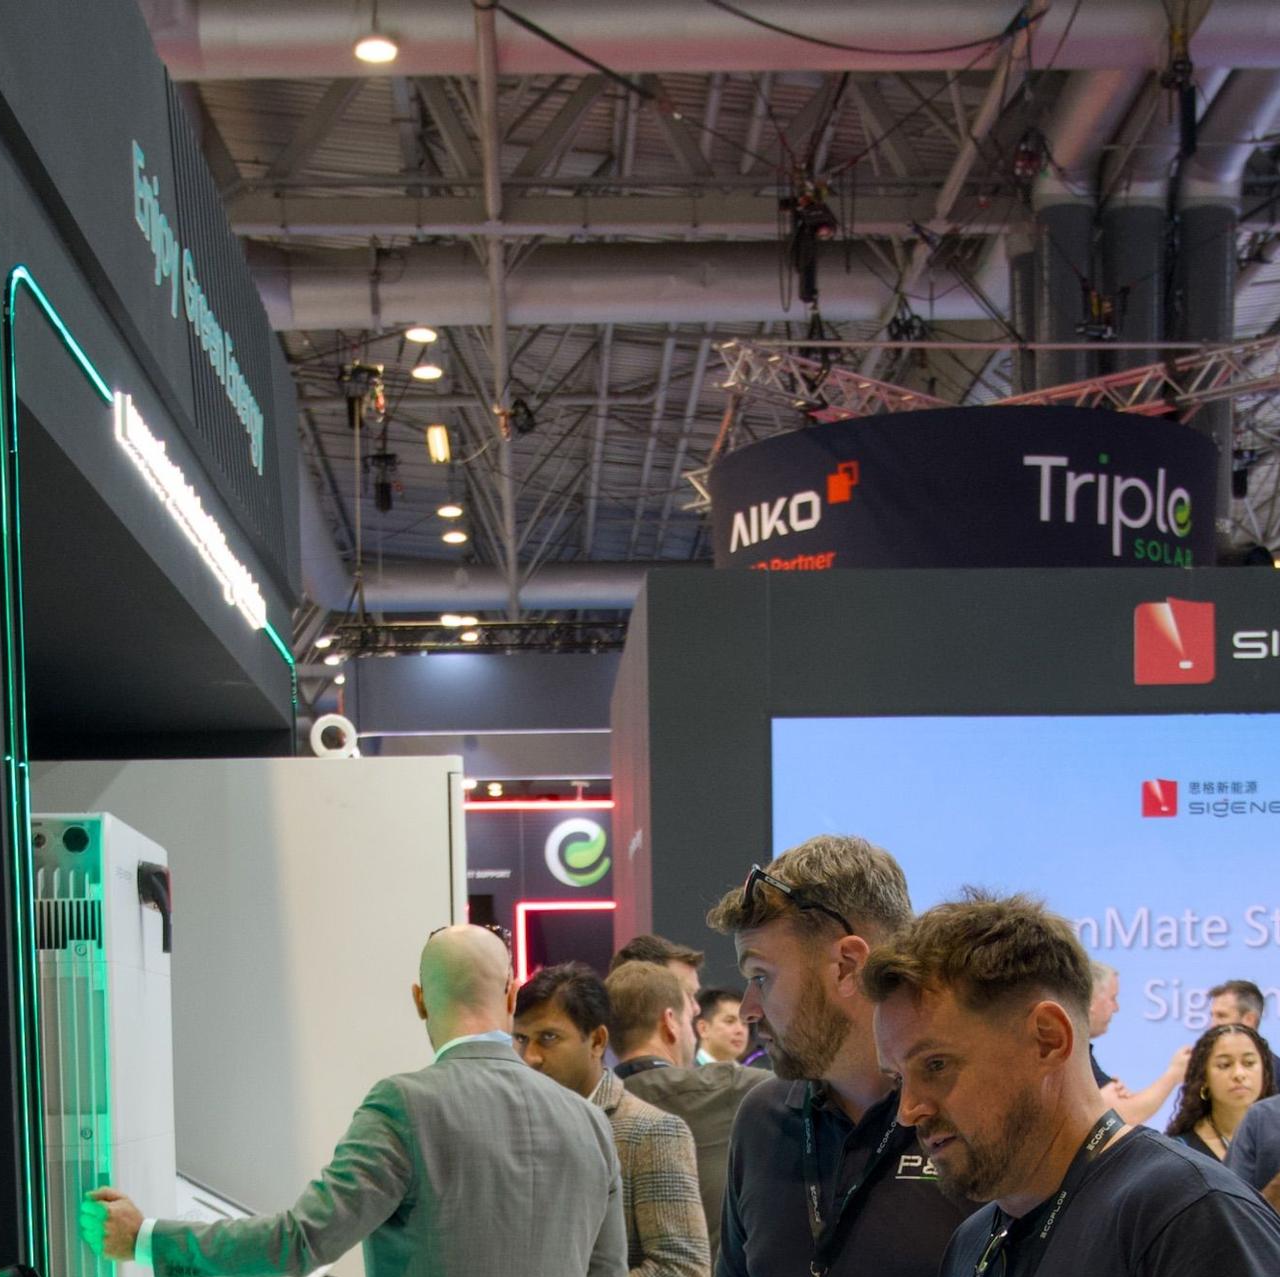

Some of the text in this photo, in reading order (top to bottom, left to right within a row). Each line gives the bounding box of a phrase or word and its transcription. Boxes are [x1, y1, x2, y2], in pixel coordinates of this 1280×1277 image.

[132, 139, 179, 319] Enjoy
[730, 490, 821, 553] AIKO
[1023, 453, 1193, 558] Triple
[1134, 538, 1193, 570] SOLAR
[1189, 780, 1258, 795] 思格新能源
[1074, 905, 1229, 949] nMate
[876, 1121, 897, 1154] ECOFLO
[1040, 1190, 1067, 1239] ECOFLOW
